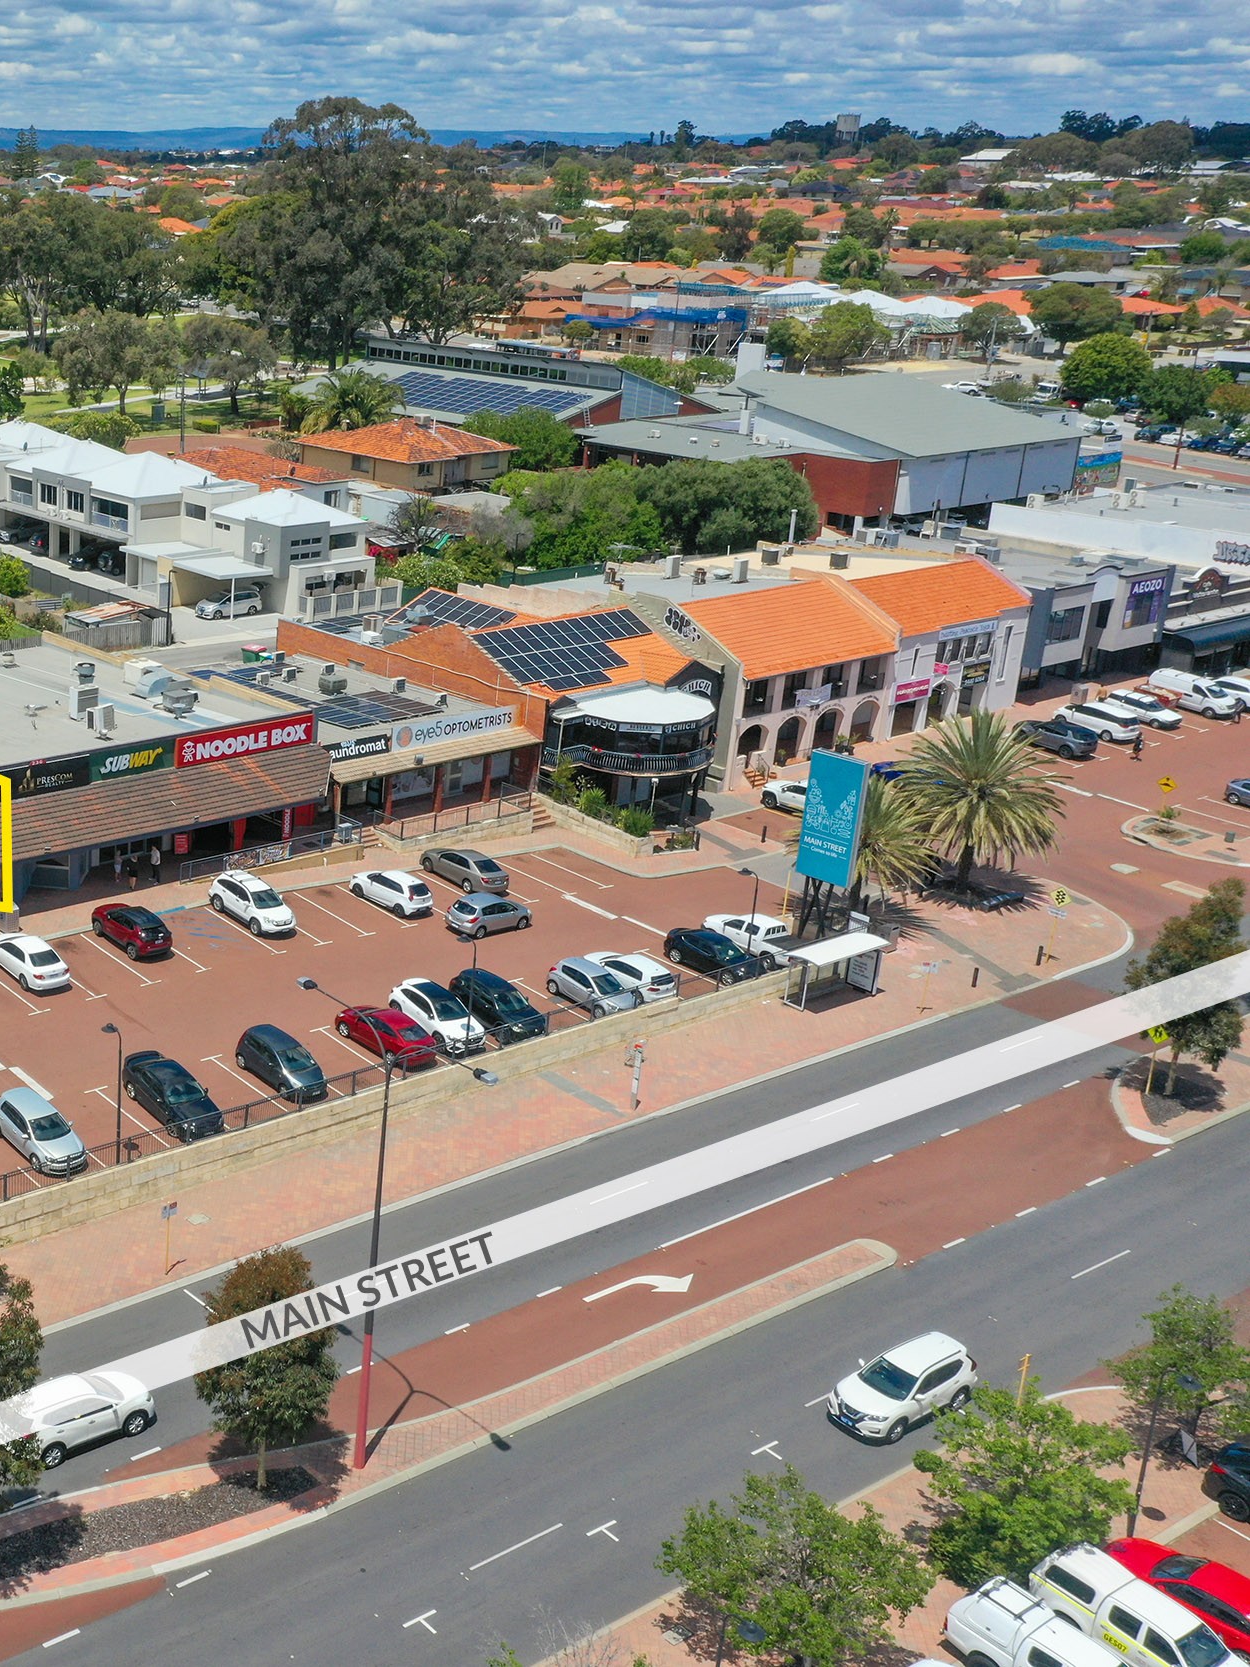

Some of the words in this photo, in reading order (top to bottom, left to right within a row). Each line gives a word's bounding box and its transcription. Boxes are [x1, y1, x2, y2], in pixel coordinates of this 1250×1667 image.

[1132, 578, 1162, 595] AEOZO
[414, 720, 443, 744] eye5
[443, 712, 512, 735] OPTOMETRISTS
[196, 731, 268, 760] NOODLE
[271, 723, 307, 746] BOX
[329, 738, 387, 759] aundromat
[100, 747, 163, 774] SUBWAY
[44, 780, 65, 788] REALTY
[803, 835, 823, 847] MAIN
[822, 841, 847, 854] STREET
